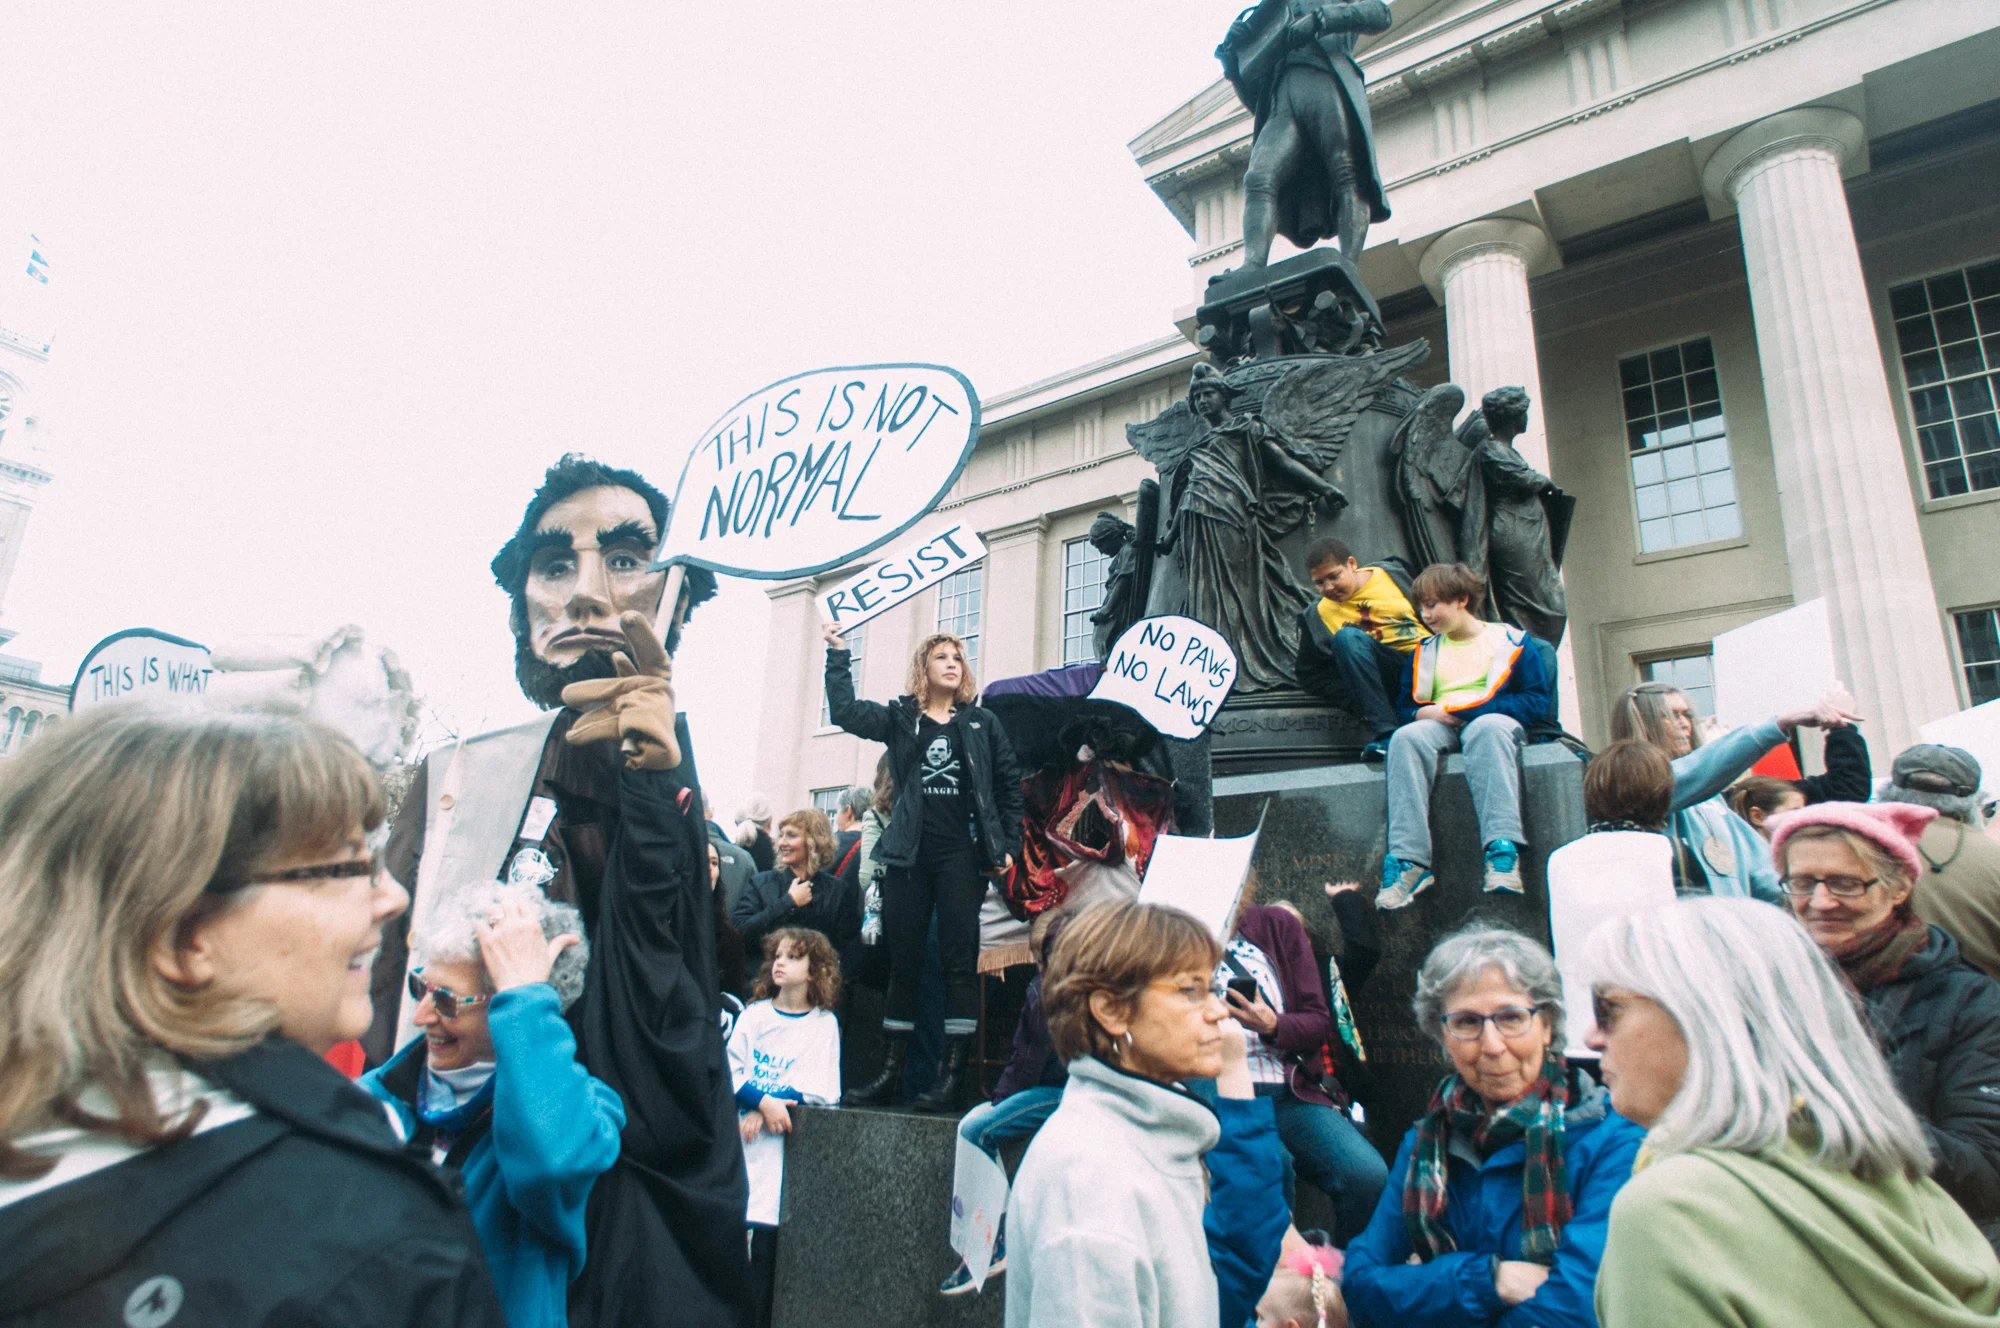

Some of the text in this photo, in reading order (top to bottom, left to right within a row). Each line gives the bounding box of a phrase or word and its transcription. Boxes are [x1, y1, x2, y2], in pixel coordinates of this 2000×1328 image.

[702, 381, 958, 471] THIS IS NOT
[700, 438, 882, 540] NORMAL
[826, 525, 967, 621] RESIST
[90, 656, 214, 702] THIS IS WHAT
[1113, 650, 1213, 726] NO LAWS
[1140, 622, 1231, 688] NO PAWS
